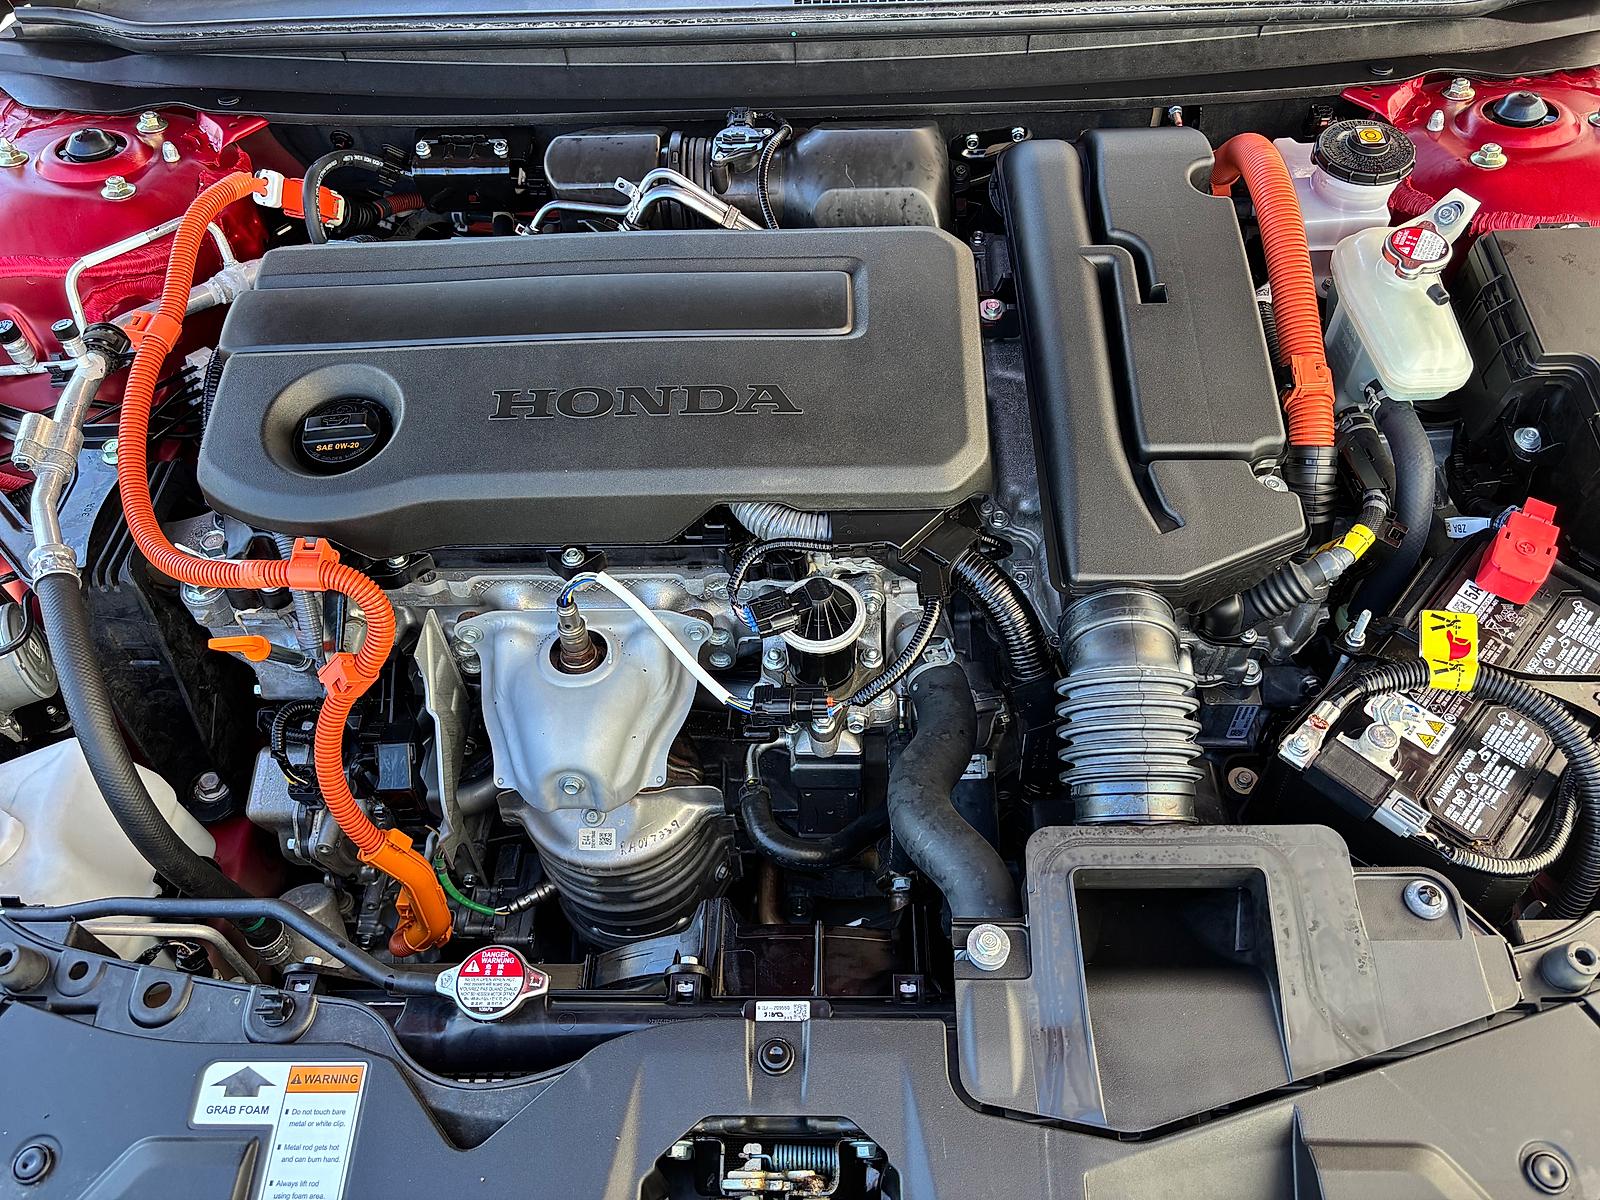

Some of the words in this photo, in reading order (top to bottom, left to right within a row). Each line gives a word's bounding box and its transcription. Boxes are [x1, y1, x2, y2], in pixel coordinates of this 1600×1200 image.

[488, 383, 804, 420] HONDA
[315, 444, 333, 452] SAE
[334, 441, 360, 450] 0W-20
[304, 1074, 359, 1084] WARNING
[206, 1105, 237, 1115] GRAB
[238, 1105, 270, 1115] FOAM
[291, 1108, 301, 1116] Do
[302, 1108, 313, 1116] not
[313, 1108, 331, 1116] touch
[332, 1108, 347, 1116] bare
[333, 1120, 346, 1128] clip.
[283, 1143, 302, 1151] Metal
[302, 1143, 314, 1151] rod
[314, 1144, 328, 1152] gets
[328, 1143, 340, 1151] hot
[281, 1155, 294, 1163] and
[307, 1155, 322, 1163] burn
[322, 1155, 341, 1163] hand.
[275, 1180, 299, 1189] Always
[299, 1179, 308, 1187] lift
[291, 1192, 308, 1200] foam
